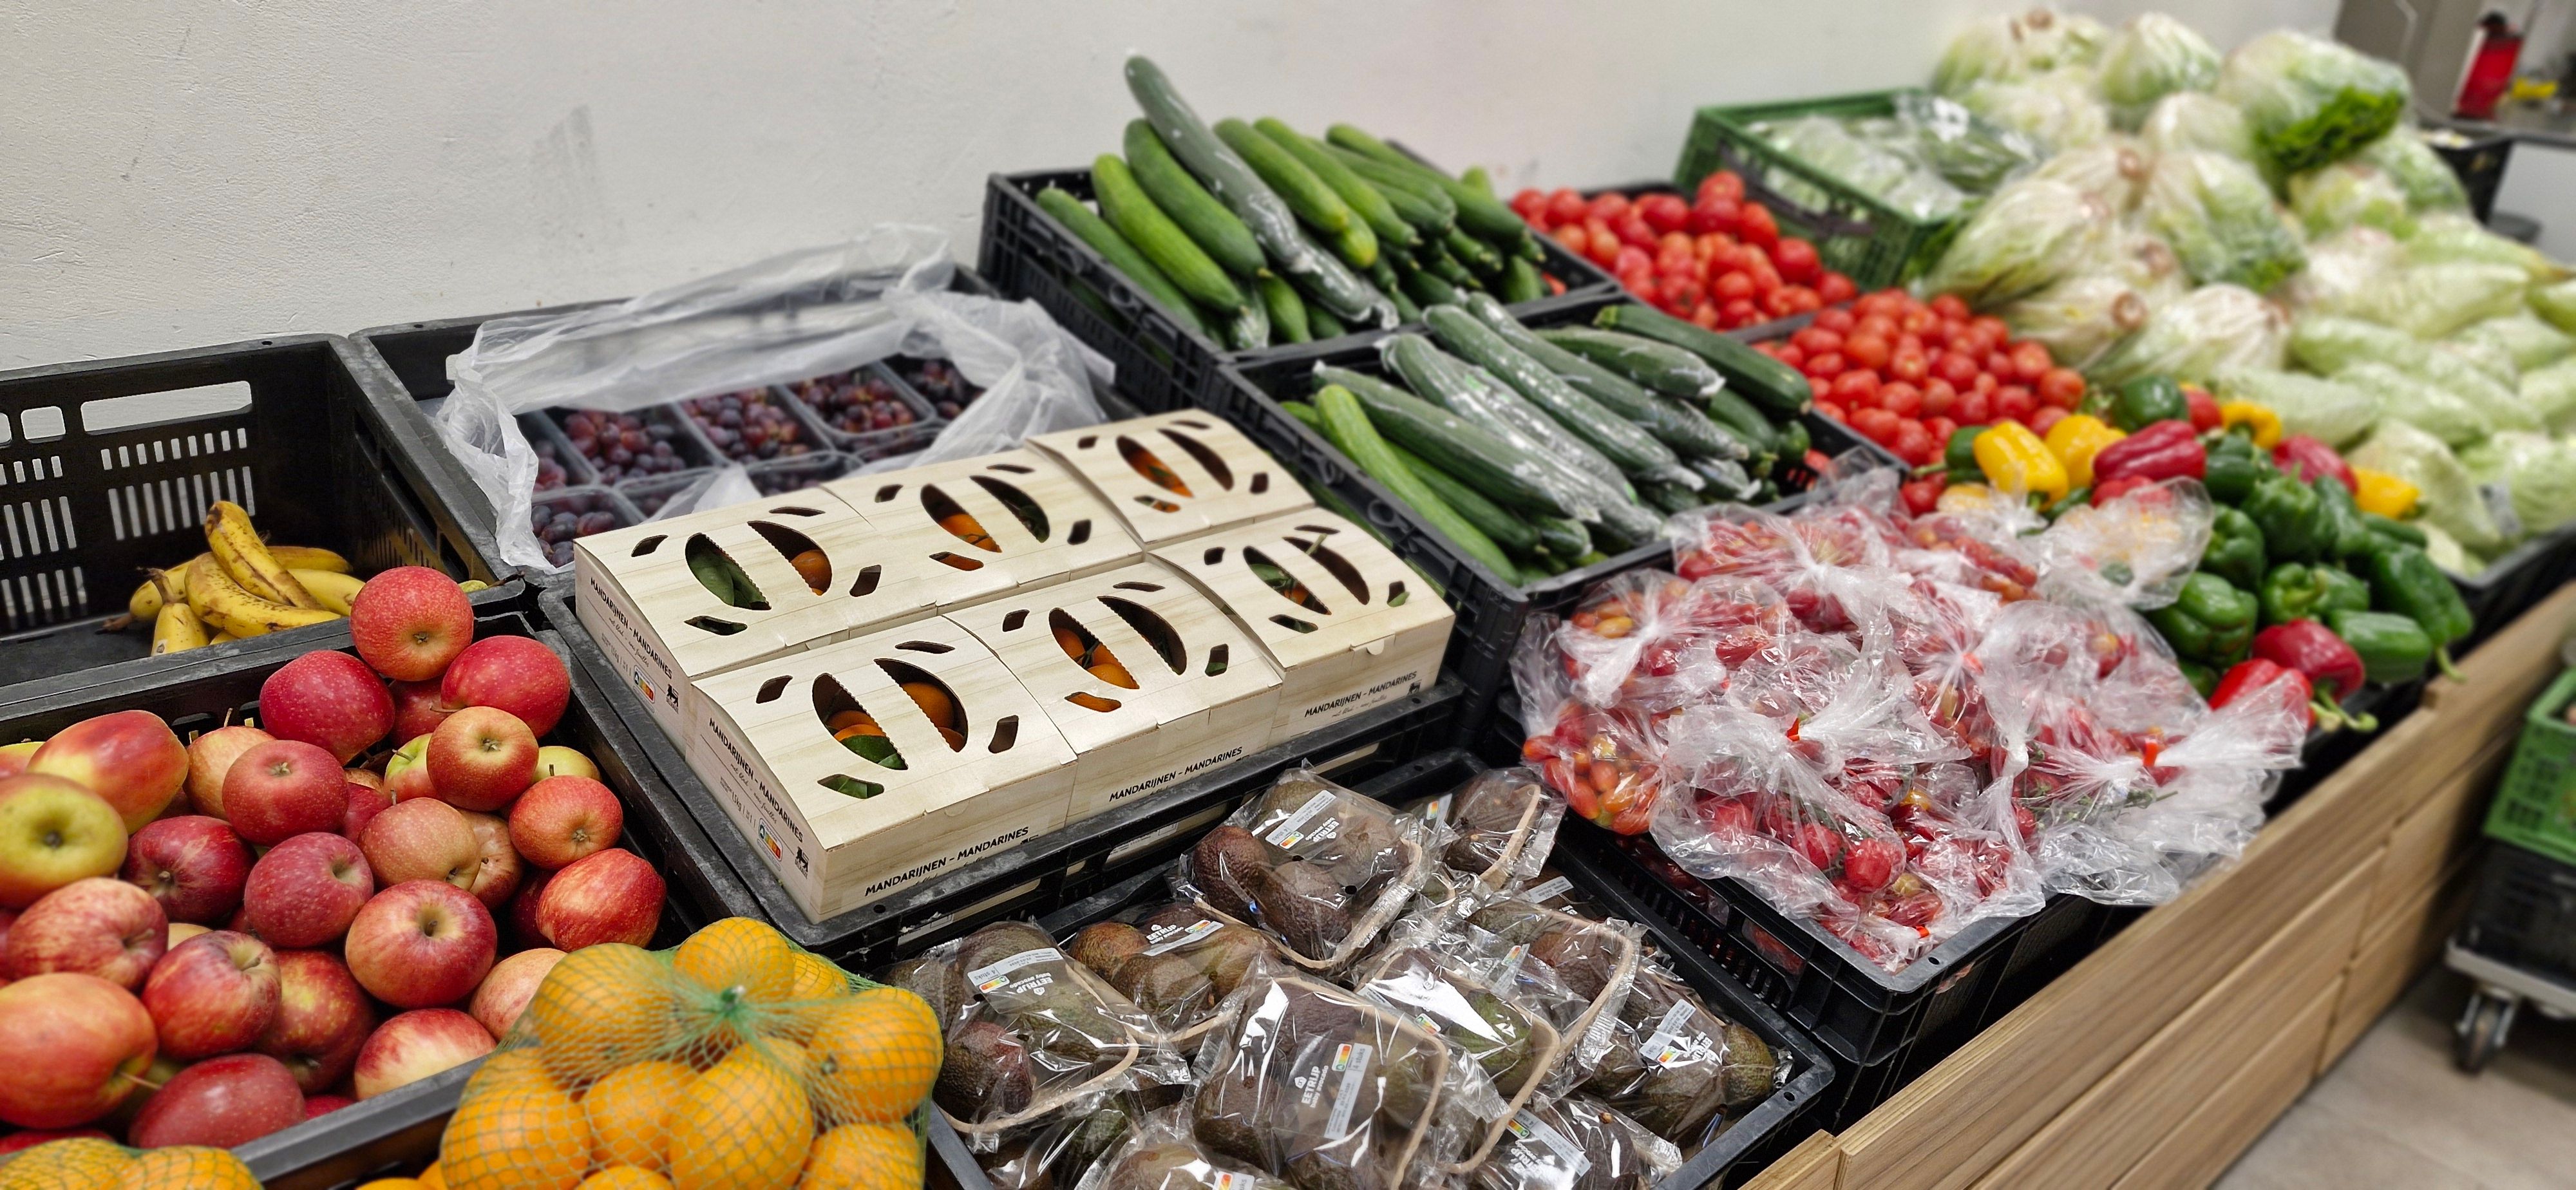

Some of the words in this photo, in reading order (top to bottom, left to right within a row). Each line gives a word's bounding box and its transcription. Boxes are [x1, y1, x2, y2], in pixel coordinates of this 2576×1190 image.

[591, 577, 629, 630] MANDARIJNEN
[633, 628, 672, 680] MANDARINES
[1305, 692, 1362, 717] MANDARIJNEN
[1368, 671, 1417, 696] MANDARINES
[709, 717, 753, 780] MANDARIJNEN
[759, 781, 803, 843] MANDARINES
[1109, 771, 1177, 802] MANDARIJNEN
[1184, 746, 1242, 775] MANDARINES
[865, 857, 947, 896] MANDARIJNEN
[957, 827, 1029, 860] MANDARINES
[1016, 977, 1054, 994] EETRIJP
[1301, 1066, 1321, 1104] EETRIJP
